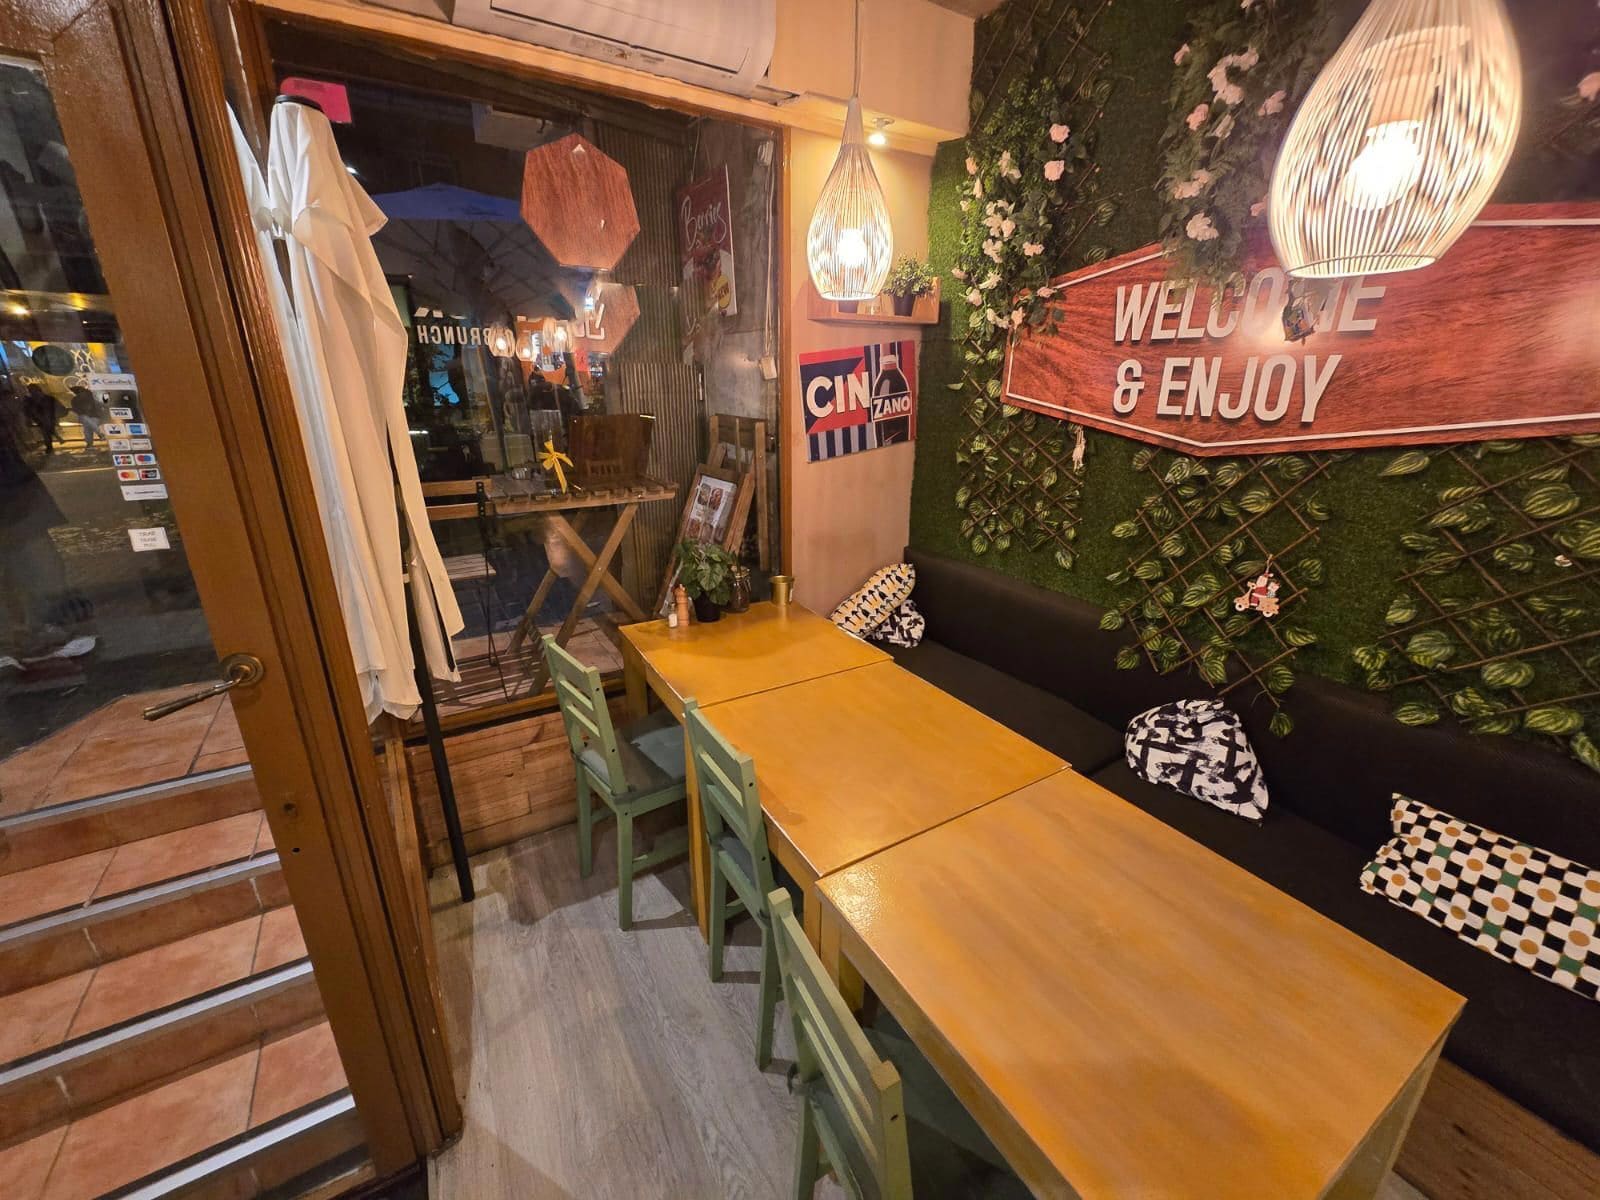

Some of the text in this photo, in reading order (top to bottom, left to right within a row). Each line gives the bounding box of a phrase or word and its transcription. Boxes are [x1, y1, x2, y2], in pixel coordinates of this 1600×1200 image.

[806, 372, 910, 418] CIN ZANO
[1113, 355, 1343, 422] & ENJOY
